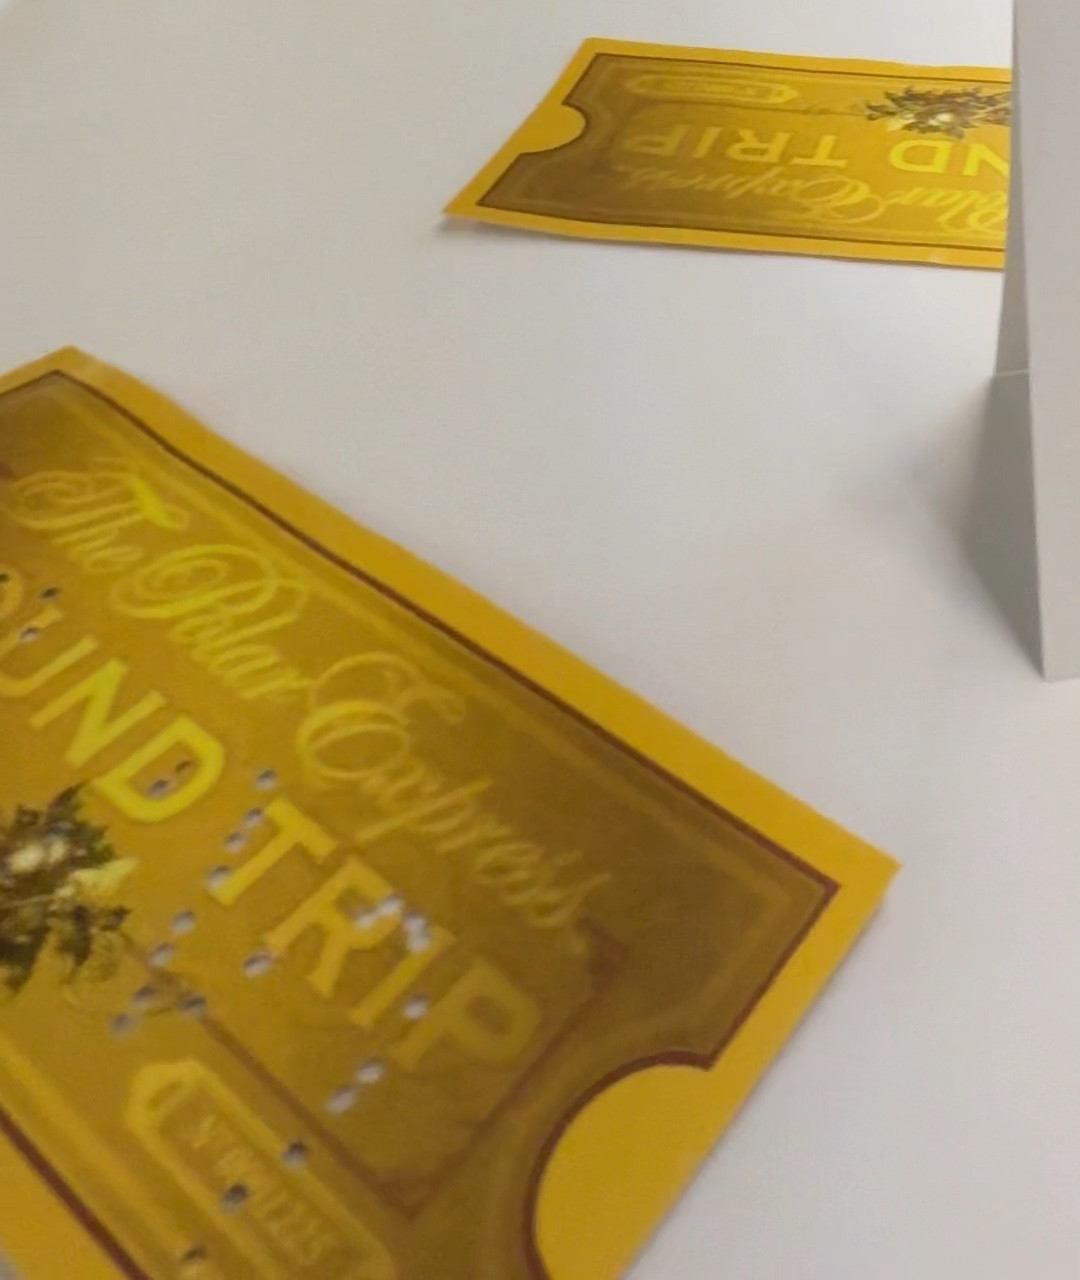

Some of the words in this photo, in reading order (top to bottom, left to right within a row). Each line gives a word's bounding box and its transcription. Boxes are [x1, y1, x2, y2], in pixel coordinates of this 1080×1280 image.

[624, 123, 849, 168] TRIP
[2, 458, 191, 577] The
[108, 543, 322, 706] Polar
[296, 650, 610, 929] Express
[208, 795, 542, 1072] TRIP
